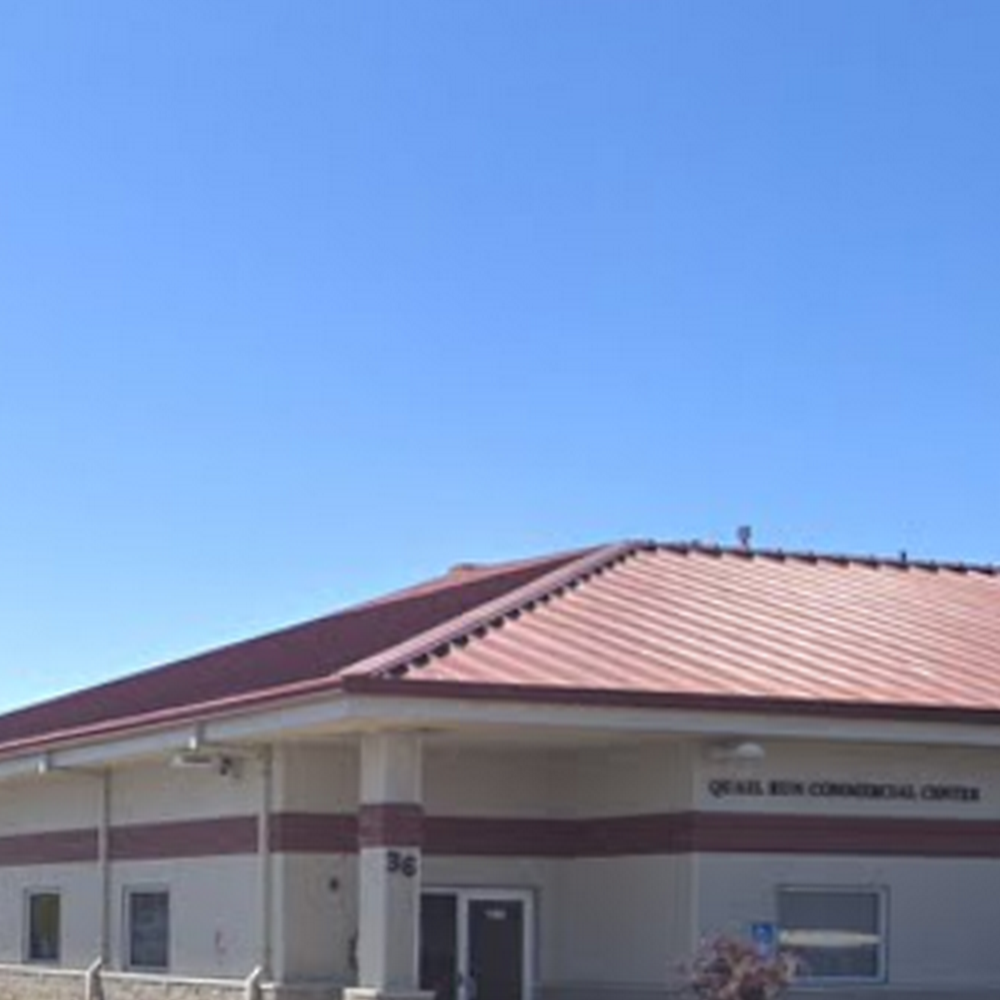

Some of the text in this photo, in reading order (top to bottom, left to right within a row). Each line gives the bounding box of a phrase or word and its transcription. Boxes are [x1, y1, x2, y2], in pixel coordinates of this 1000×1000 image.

[707, 779, 764, 798] QUAIL
[920, 783, 981, 802] CENTER
[386, 851, 417, 877] 36
